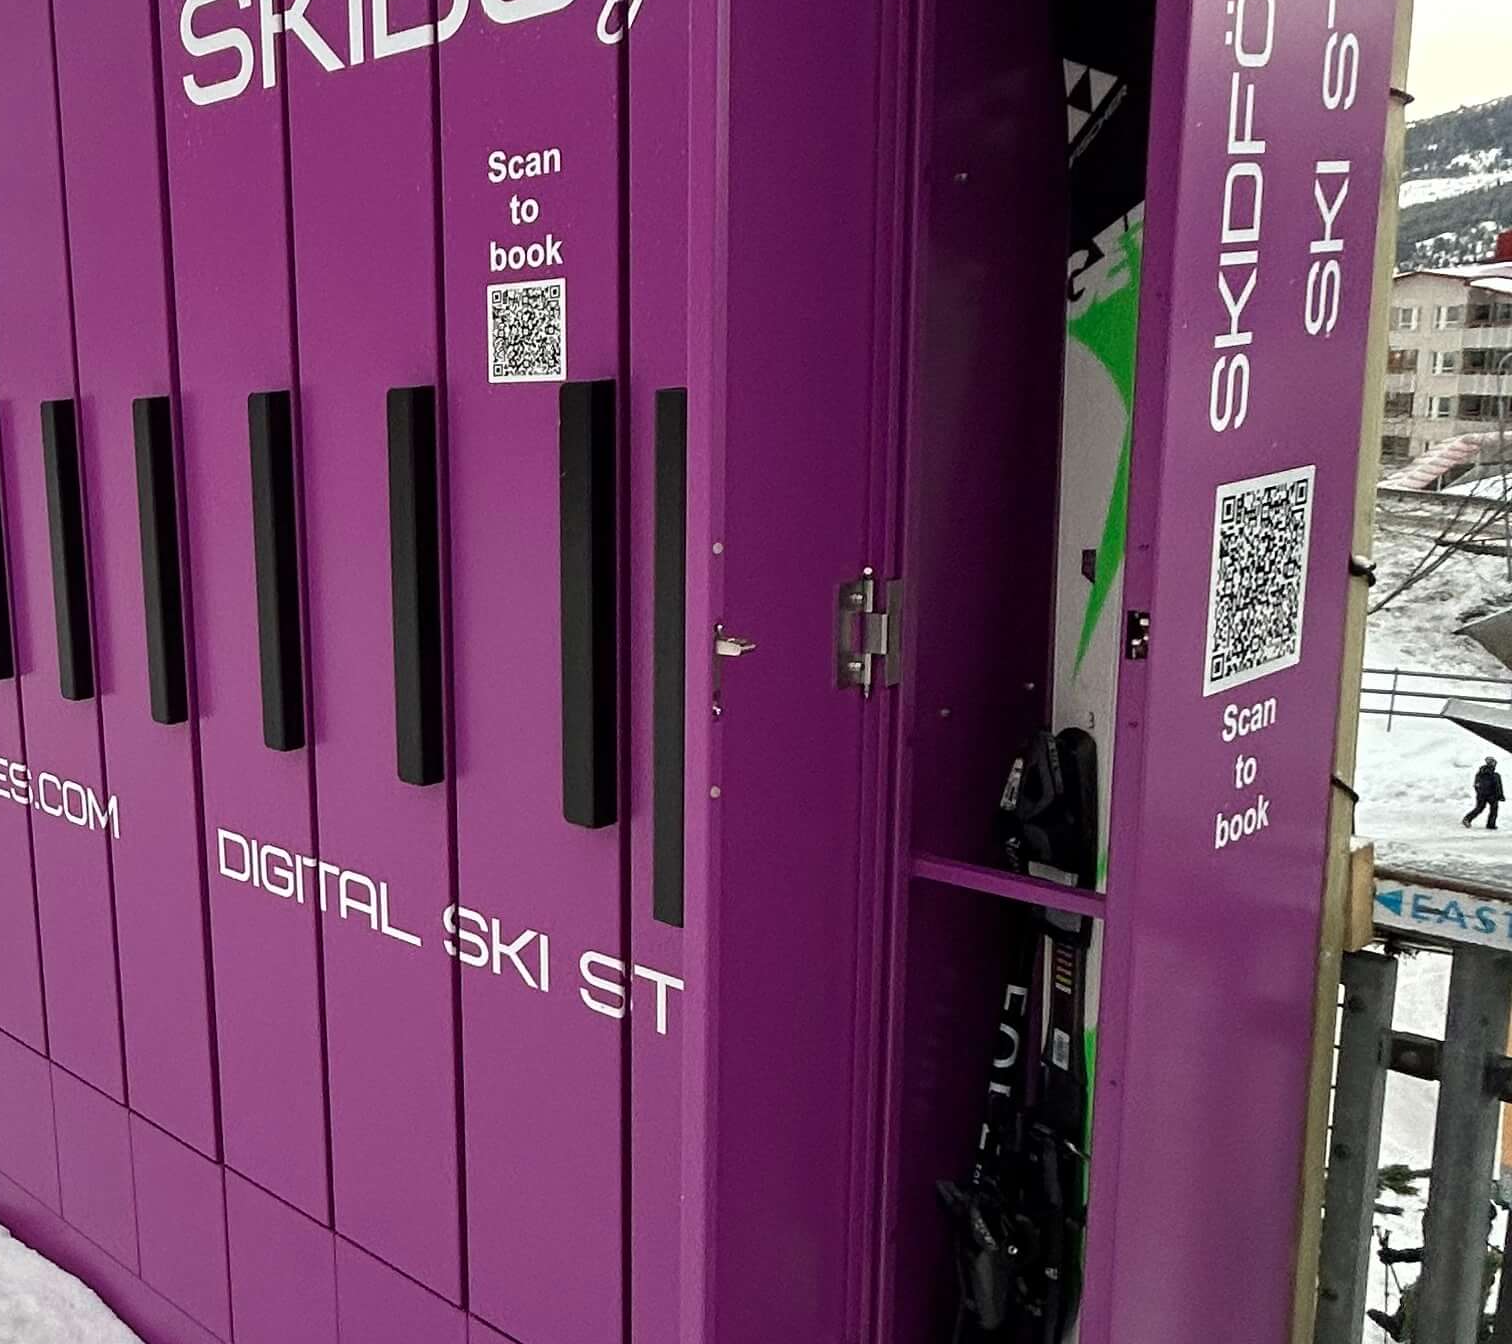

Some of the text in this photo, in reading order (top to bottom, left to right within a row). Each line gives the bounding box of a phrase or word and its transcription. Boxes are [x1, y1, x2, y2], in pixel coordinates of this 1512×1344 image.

[488, 148, 561, 183] Scan
[509, 194, 539, 225] to
[489, 234, 563, 272] book
[1305, 159, 1351, 336] SKI
[1222, 697, 1276, 742] Scan
[1235, 754, 1257, 789] to
[1215, 794, 1269, 849] book
[217, 828, 422, 946] DIGITAL
[441, 902, 549, 992] SKI
